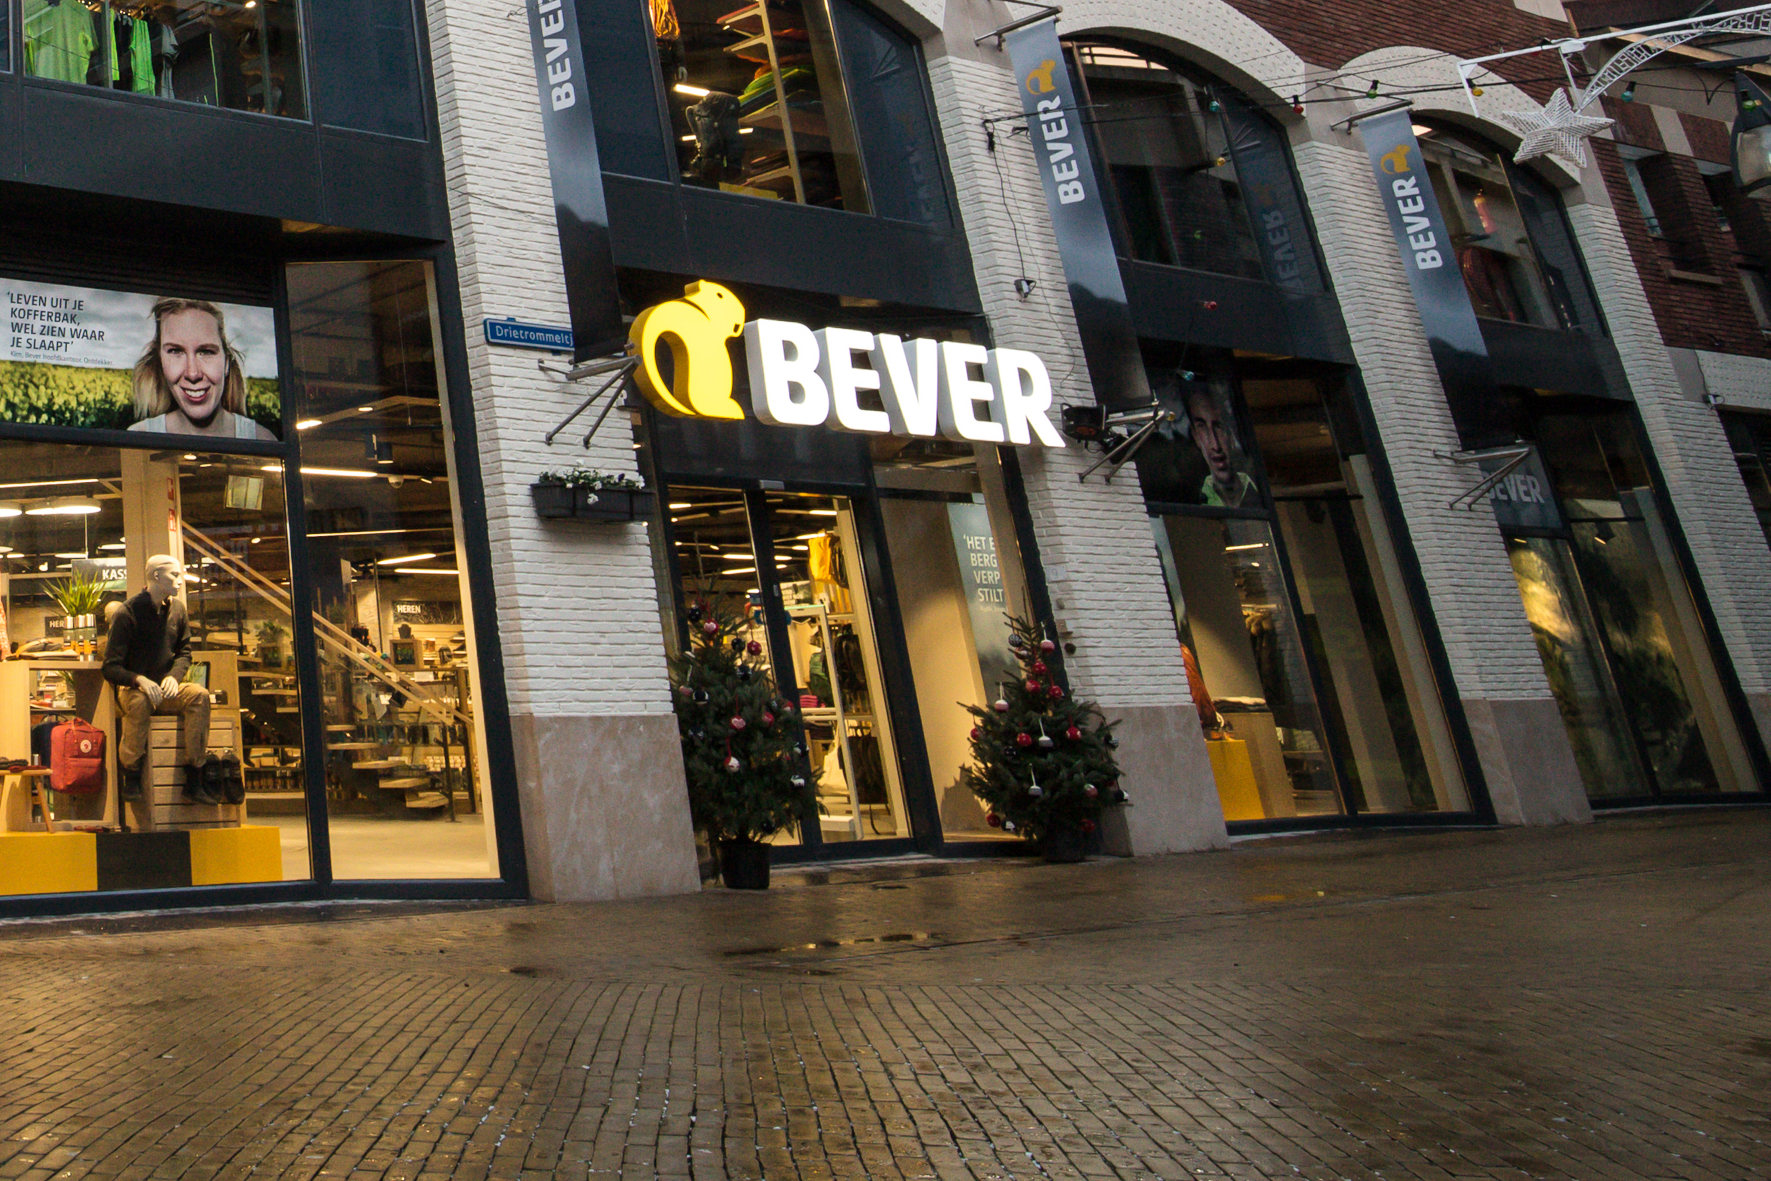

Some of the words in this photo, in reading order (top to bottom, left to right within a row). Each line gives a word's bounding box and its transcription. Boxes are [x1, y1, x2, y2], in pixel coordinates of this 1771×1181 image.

[1037, 94, 1085, 205] BEVER
[1392, 175, 1443, 270] BEVER
[50, 297, 69, 309] UIT
[72, 300, 84, 311] JE
[10, 307, 81, 326] KOFFERBAK,
[11, 322, 36, 335] WEL
[39, 325, 66, 338] ZIEN
[70, 327, 105, 341] WAAR
[10, 336, 22, 348] JE
[745, 318, 1067, 448] BEVER
[396, 604, 422, 614] HEREN
